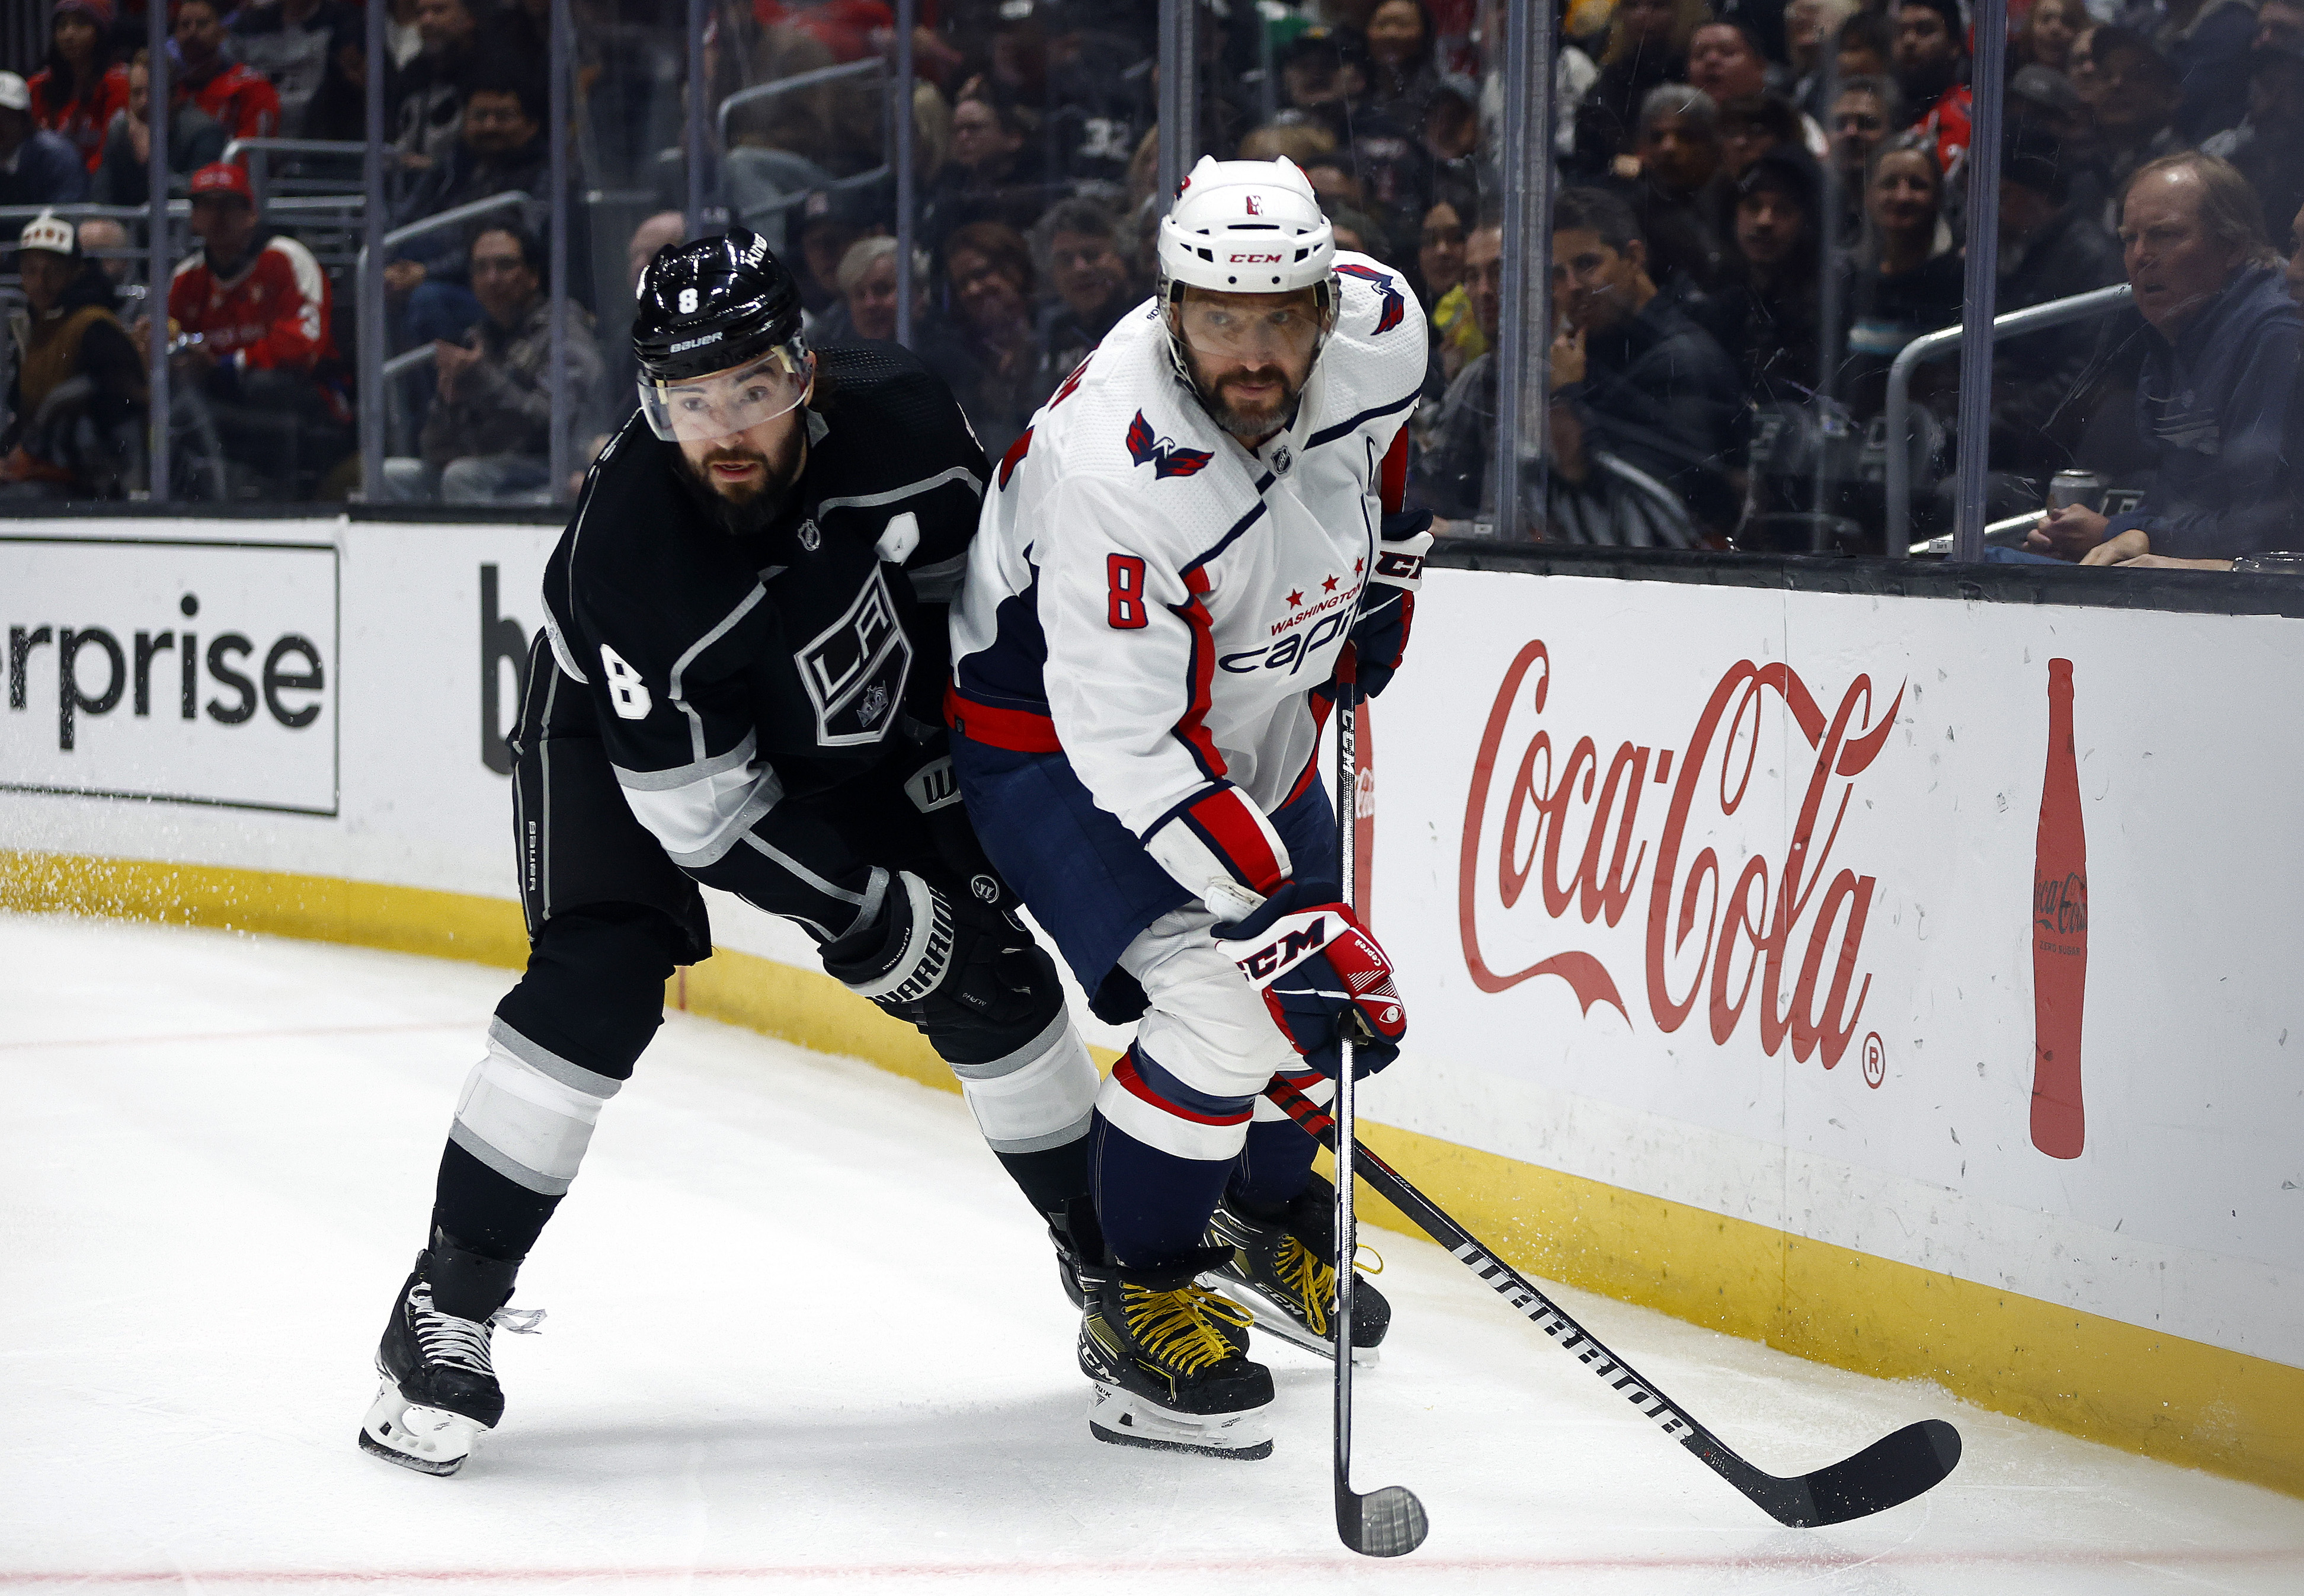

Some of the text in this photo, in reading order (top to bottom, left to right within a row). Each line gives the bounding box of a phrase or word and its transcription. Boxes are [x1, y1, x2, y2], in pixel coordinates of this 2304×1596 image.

[1228, 254, 1283, 263] CCM
[679, 288, 699, 314] 8
[670, 331, 723, 354] BAUER
[1107, 552, 1149, 629] 8
[1271, 578, 1362, 637] WASHINGTON
[0, 593, 324, 750] rprise
[812, 586, 889, 701] LA
[599, 643, 652, 719] 8
[1342, 709, 1355, 776] CCM
[528, 821, 536, 891] BAUER
[1459, 638, 1907, 1070] Coca-Cola
[2040, 940, 2056, 953] ZERO
[1254, 1282, 1305, 1316] CCM
[1451, 1242, 1694, 1447] WARRIOR
